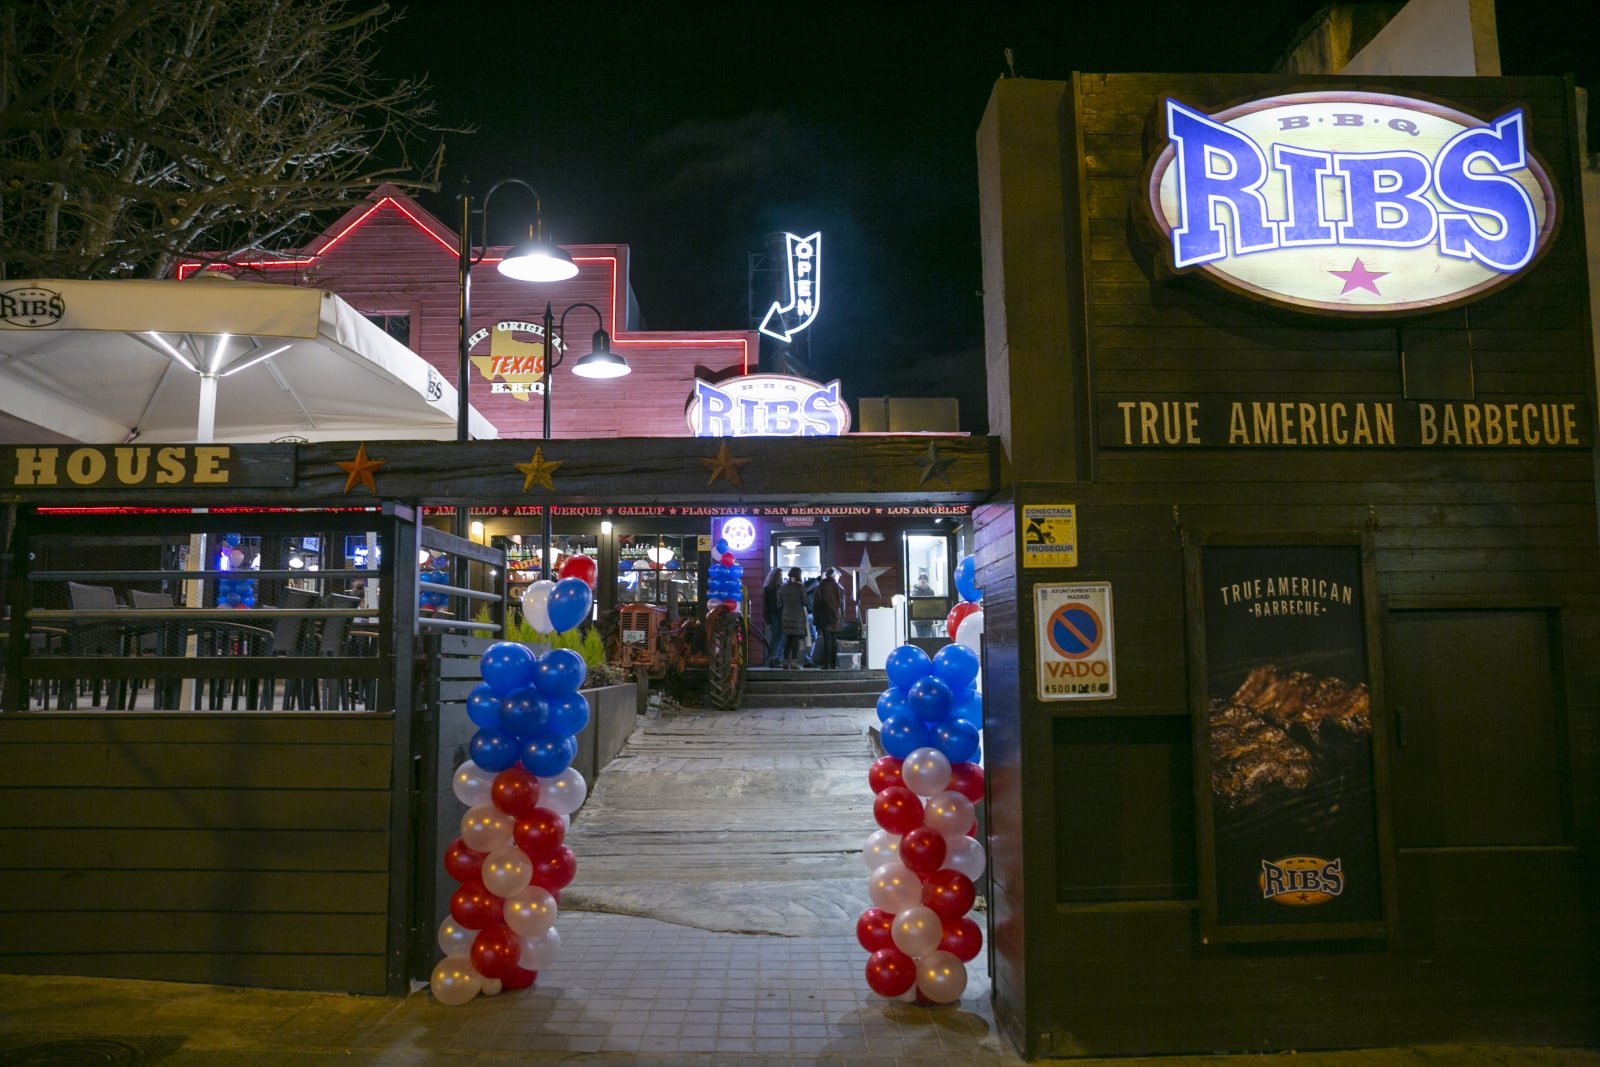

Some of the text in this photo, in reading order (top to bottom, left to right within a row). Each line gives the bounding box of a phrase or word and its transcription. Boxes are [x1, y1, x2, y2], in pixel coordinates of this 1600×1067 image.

[1166, 97, 1537, 272] RIBS
[795, 242, 813, 316] OPEN
[0, 291, 62, 320] RIBS
[490, 355, 545, 374] TEXAS
[696, 379, 841, 437] RIBS
[1118, 402, 1579, 446] TRUE AMERICAN BARBECUE
[14, 447, 231, 485] HOUSE
[618, 507, 665, 516] GALLUP
[682, 507, 748, 516] FLAGSTAFF
[764, 507, 789, 515] SAN
[791, 507, 871, 515] BERNARDINO
[887, 507, 910, 515] LOS
[912, 506, 967, 515] ANGELES
[1027, 545, 1073, 553] PROSEGUR
[1220, 576, 1352, 605] TRUE AMERICAN
[1254, 600, 1320, 617] BARBECUE
[1045, 660, 1107, 678] VADO
[1262, 857, 1344, 899] RIBS
